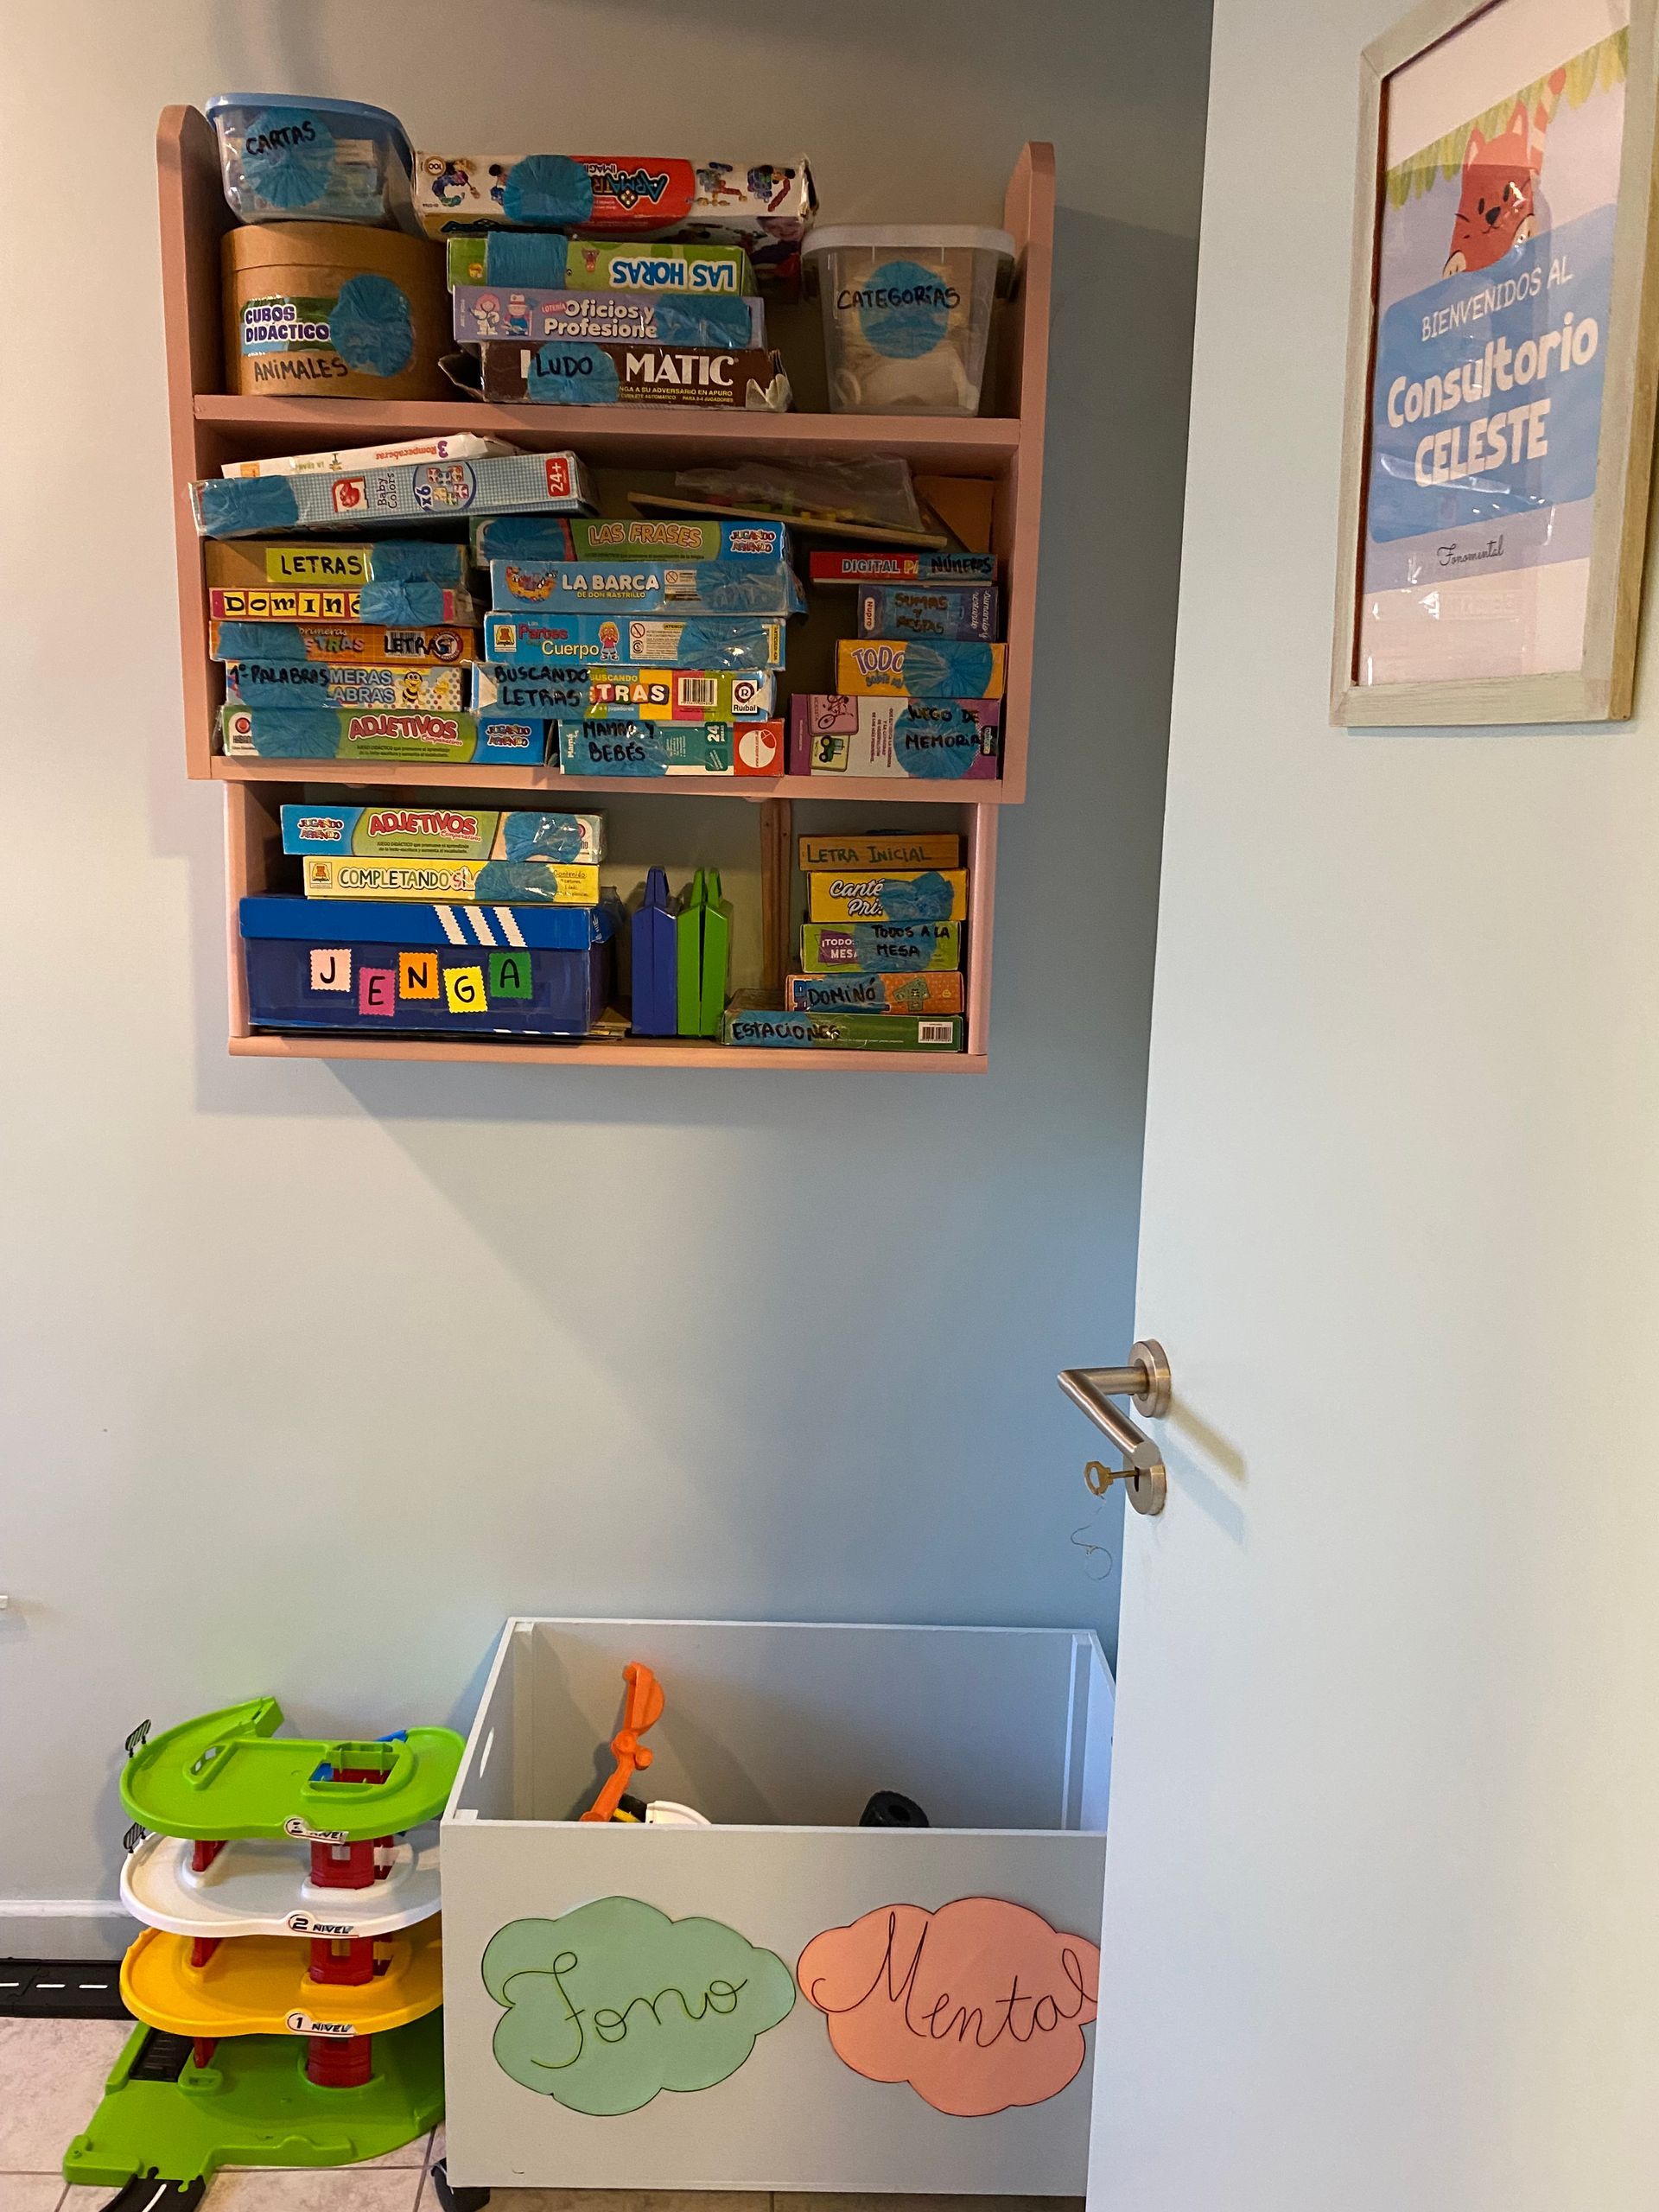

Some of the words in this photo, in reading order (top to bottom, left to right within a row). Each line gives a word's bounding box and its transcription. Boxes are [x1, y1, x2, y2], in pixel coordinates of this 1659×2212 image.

[245, 120, 316, 156] CARTAS
[585, 163, 616, 173] IMAGI
[591, 168, 669, 204] ARMATR
[612, 261, 683, 286] HORAS
[693, 264, 733, 288] LAS
[1421, 265, 1541, 342] BIENVENIDOS
[1546, 256, 1574, 290] AL
[245, 306, 296, 324] CUBOS
[566, 299, 639, 320] Oficios
[643, 307, 654, 324] y
[245, 322, 330, 342] DIDÁCTICO
[544, 317, 658, 338] Profesione
[536, 353, 593, 378] LUDO
[626, 353, 734, 386] MATIC
[1387, 311, 1599, 429] Consultorio
[437, 441, 448, 459] 3
[1415, 398, 1551, 488] CELESTE
[550, 462, 563, 493] 24+
[377, 478, 387, 506] Baby
[387, 473, 397, 509] Colors
[416, 486, 432, 506] x6
[589, 524, 626, 546] LAS
[630, 522, 702, 548] FRASES
[1436, 534, 1504, 567] Fonomental
[281, 556, 363, 575] LETRAS
[842, 559, 900, 574] DIGITAL
[563, 574, 588, 590] LA
[592, 575, 659, 591] BARCA
[519, 623, 568, 639] Partes
[305, 636, 365, 653] ETRAS
[385, 635, 454, 655] LETRAS
[542, 640, 600, 660] Cuerpo
[251, 664, 330, 686] PALABRAS
[330, 669, 392, 685] MERAS
[494, 665, 589, 683] BUSCANDO
[334, 688, 396, 703] ABRAS
[502, 686, 582, 707] LETRAS
[908, 704, 952, 721] JUEGO
[961, 709, 979, 723] DE
[349, 715, 457, 740] ADJETIVOS
[644, 722, 654, 739] Y
[707, 726, 719, 742] 24
[588, 741, 646, 762] BEBÉS
[370, 812, 476, 836] ADJETIVOS
[441, 830, 481, 842] Comparativos
[807, 844, 859, 863] LETRA
[340, 868, 449, 887] COMPLETANDO
[830, 878, 885, 897] Canté
[849, 898, 883, 915] Pri
[871, 925, 913, 938] TODOS
[920, 925, 930, 937] A
[934, 926, 950, 938] LA
[822, 938, 855, 947] ¡TODO
[876, 944, 920, 957] MESA
[319, 957, 520, 1006] JENGA
[292, 1917, 309, 1930] 2
[312, 1923, 351, 1934] NIVEL
[811, 1910, 1098, 2048] Mental
[502, 1951, 748, 2069] Fono
[296, 2017, 303, 2029] 1
[312, 2023, 349, 2032] NIVEL
